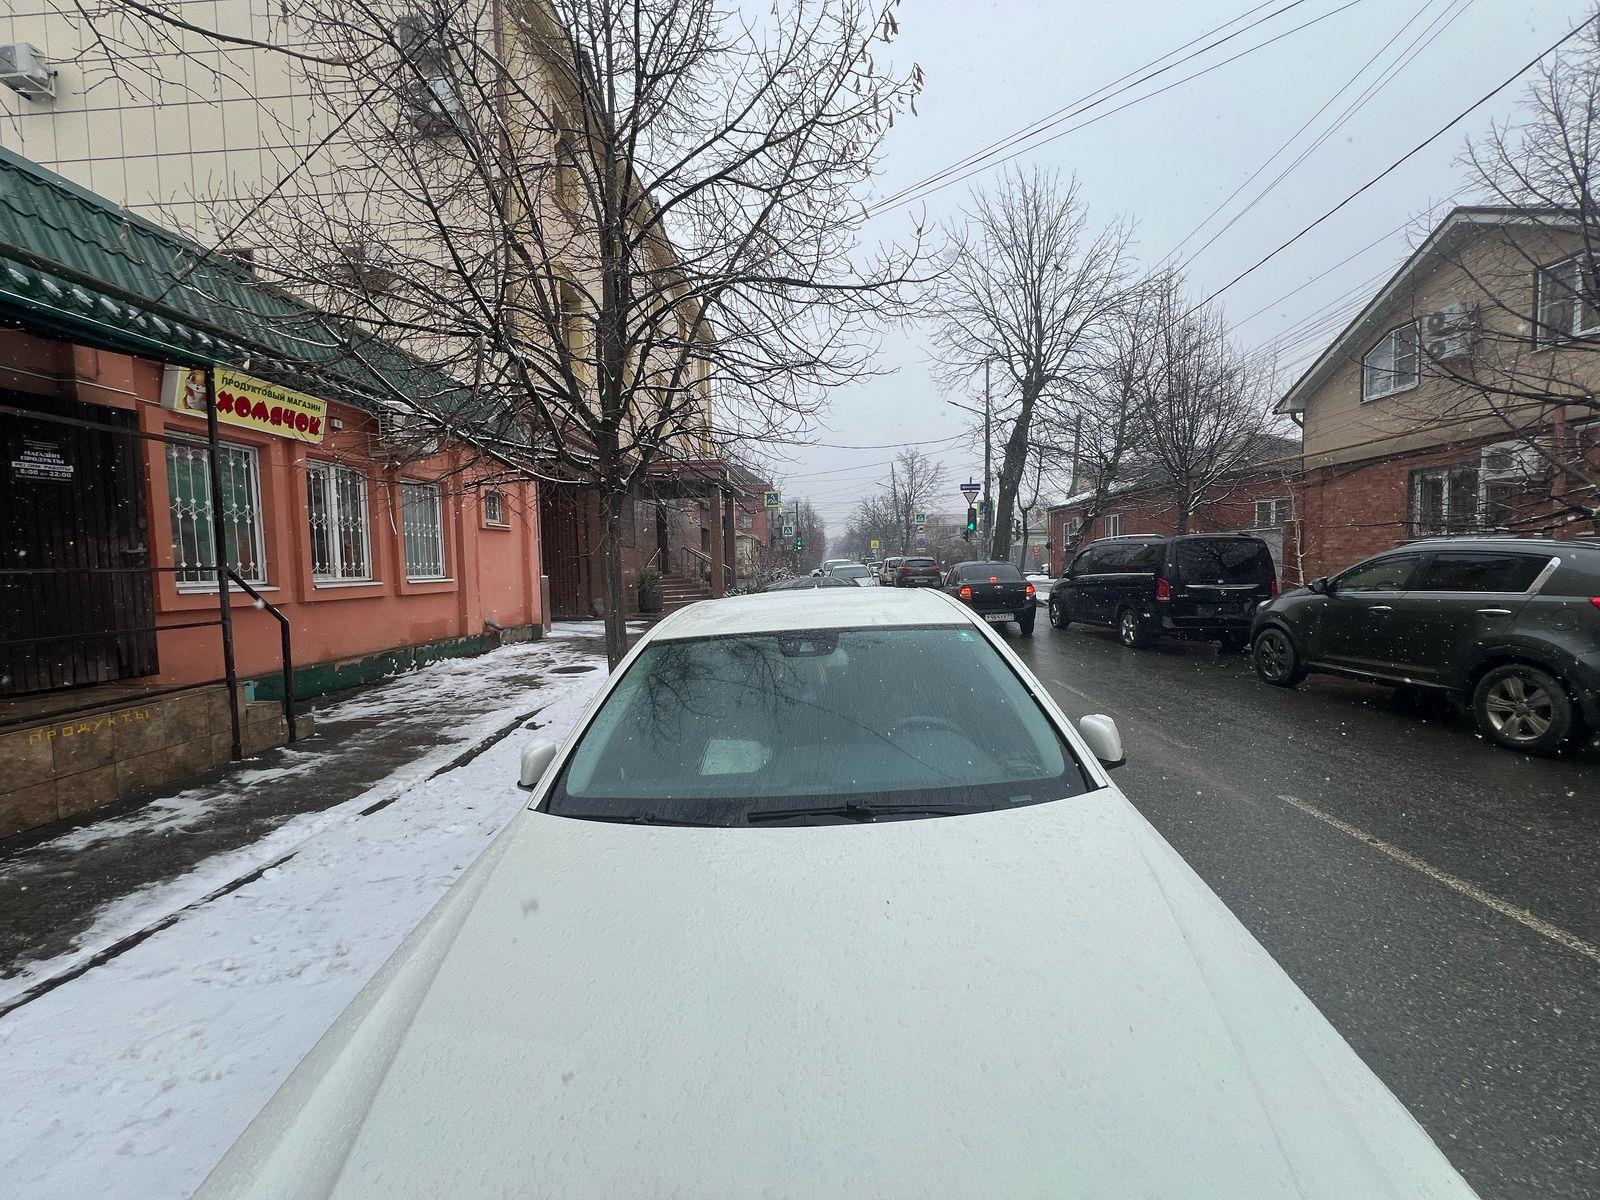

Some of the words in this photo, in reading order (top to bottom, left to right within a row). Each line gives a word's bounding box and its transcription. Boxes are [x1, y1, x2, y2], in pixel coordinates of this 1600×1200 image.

[222, 376, 286, 401] ПРОДУКТОВЫЙ
[287, 396, 321, 412] МАГАЗИН
[215, 390, 321, 436] ХОМЯЧОК
[20, 455, 65, 464] ПРОДУКТЫ
[29, 709, 149, 744] ПРОДУКТЫ
